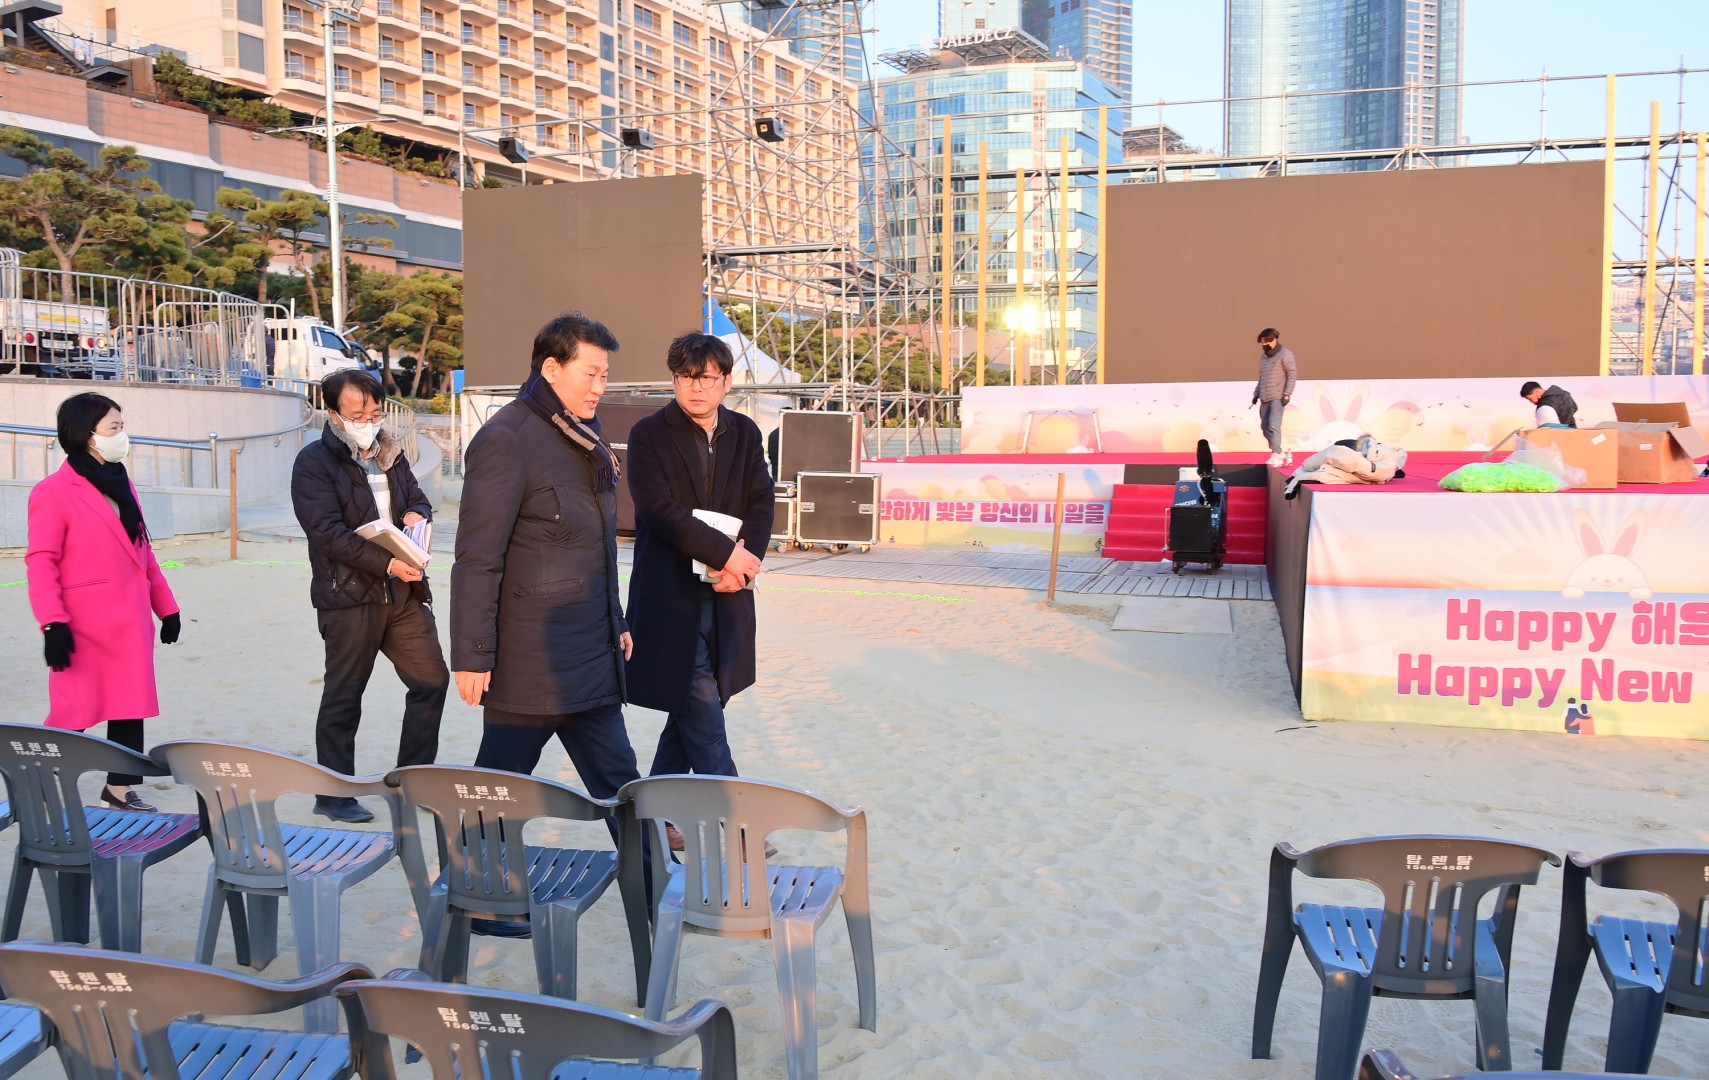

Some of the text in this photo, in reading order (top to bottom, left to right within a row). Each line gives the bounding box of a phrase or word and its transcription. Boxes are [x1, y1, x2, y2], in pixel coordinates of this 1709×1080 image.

[939, 26, 1014, 50] PALEDECZ
[936, 502, 974, 522] 빛날
[980, 502, 1039, 523] 당신의
[1446, 598, 1617, 652] Happy
[1397, 653, 1693, 709] Happy New
[443, 1021, 526, 1035] 1566-4584
